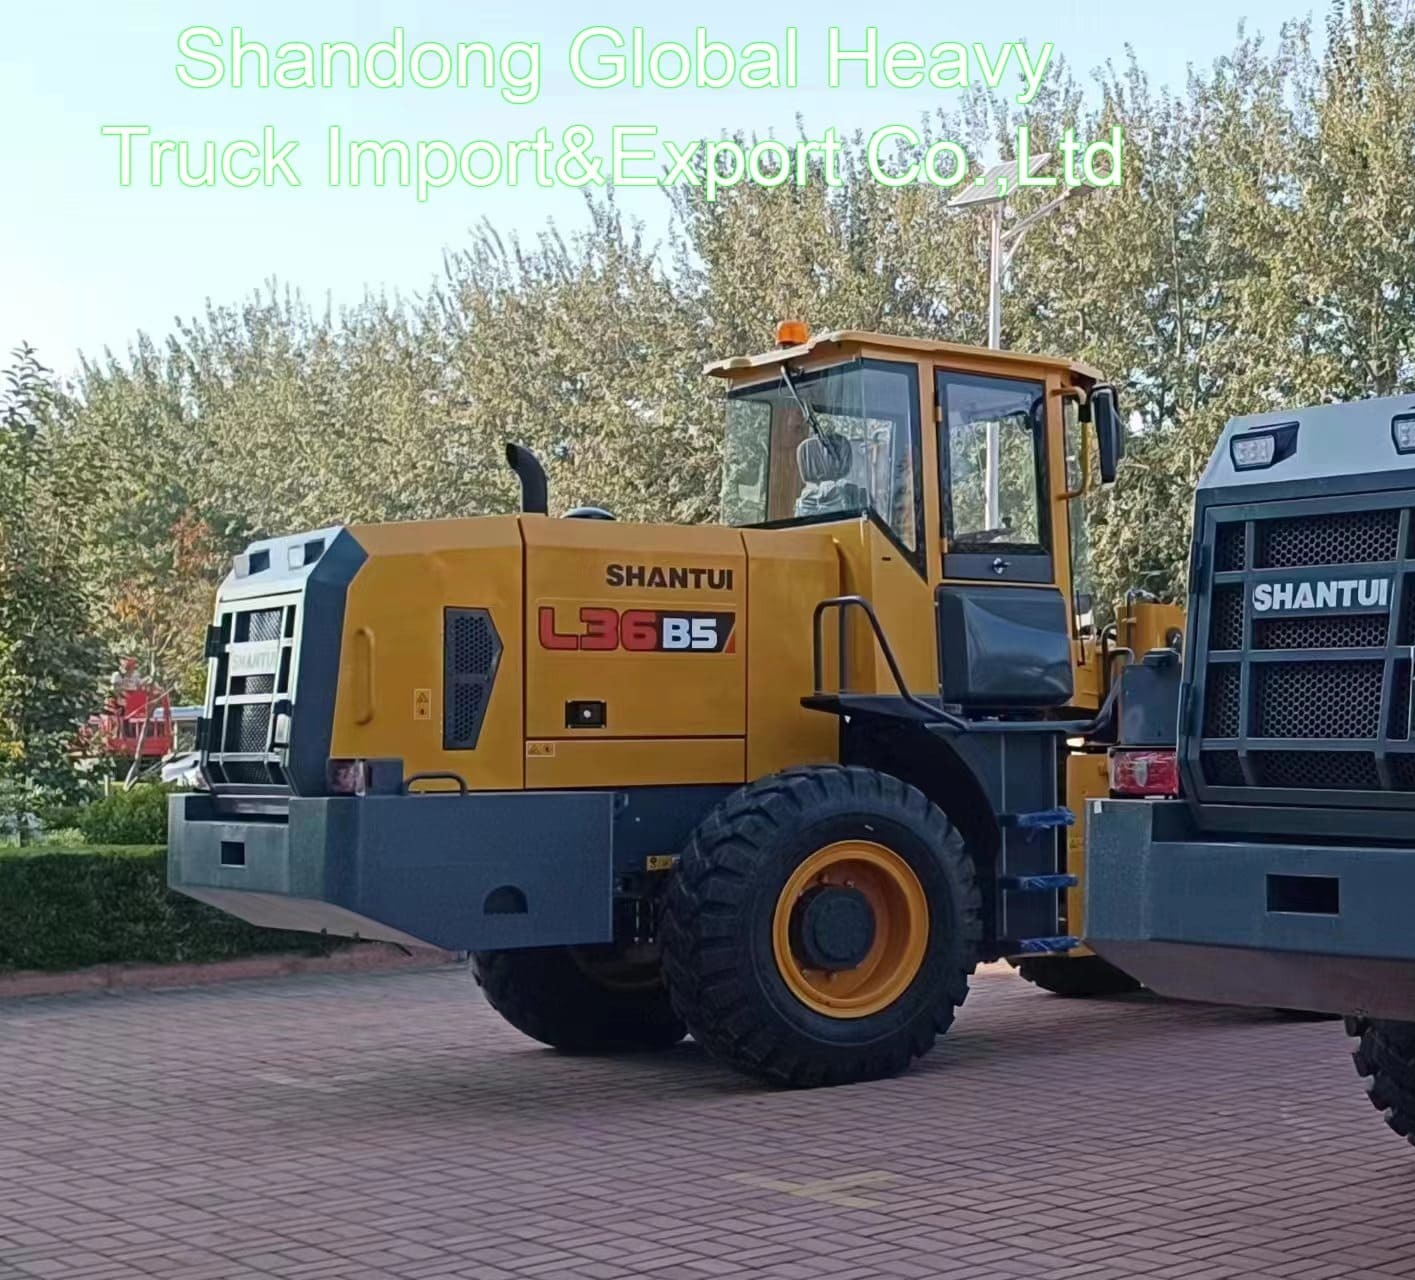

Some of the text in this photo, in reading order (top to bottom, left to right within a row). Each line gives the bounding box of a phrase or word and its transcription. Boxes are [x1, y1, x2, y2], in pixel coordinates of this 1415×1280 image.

[606, 563, 734, 591] SHANTUI
[1252, 578, 1389, 612] SHANTUI
[538, 605, 718, 652] L36B5
